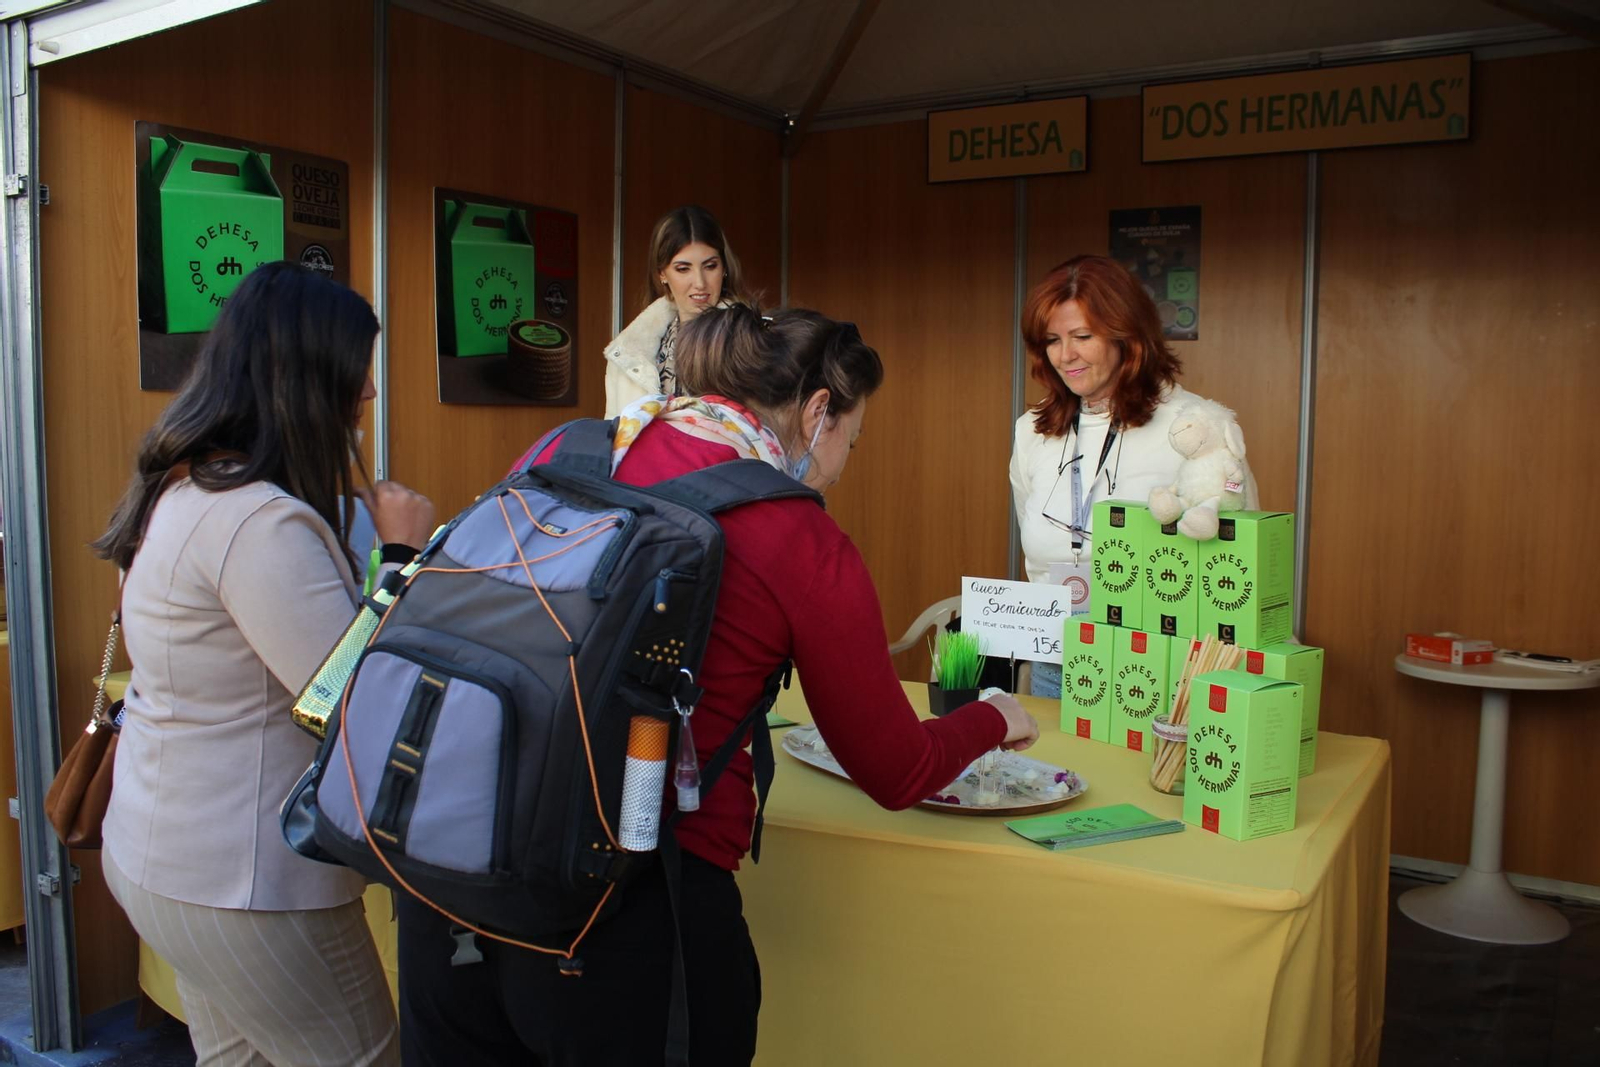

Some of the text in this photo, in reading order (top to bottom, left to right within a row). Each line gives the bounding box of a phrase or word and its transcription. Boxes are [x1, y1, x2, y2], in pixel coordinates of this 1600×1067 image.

[948, 120, 1063, 163] DEHESA
[292, 163, 339, 187] QUESO
[293, 184, 340, 207] OVEJA
[196, 222, 259, 252] DEHESA
[189, 261, 208, 294] DOS
[476, 267, 518, 289] DEHESA
[471, 298, 484, 325] DOS
[484, 298, 523, 337] HERMNAS
[1097, 538, 1135, 560] DEHESA
[1149, 546, 1189, 568] DEHESA
[1205, 553, 1248, 575] DEHESA
[971, 581, 1011, 595] Queso
[1093, 559, 1103, 581] DOS
[1102, 565, 1139, 594] HERMANAS
[1146, 568, 1194, 603] DOS HERMANAS
[1202, 575, 1253, 611] DOS HERMANAS
[983, 598, 1067, 618] Semicurado
[1111, 607, 1119, 619] C
[1164, 617, 1173, 629] C
[1222, 627, 1230, 639] C
[1032, 636, 1062, 655] 15€
[1068, 654, 1104, 676] DEHESA
[1119, 663, 1157, 686] DEHESA
[1064, 673, 1107, 707] DOS HERMANAS
[1115, 683, 1124, 705] DOS
[1122, 691, 1161, 719] HERMANAS
[1194, 724, 1237, 754] DEHESA
[1189, 747, 1200, 774] DOS
[1197, 761, 1241, 794] HERMANAS
